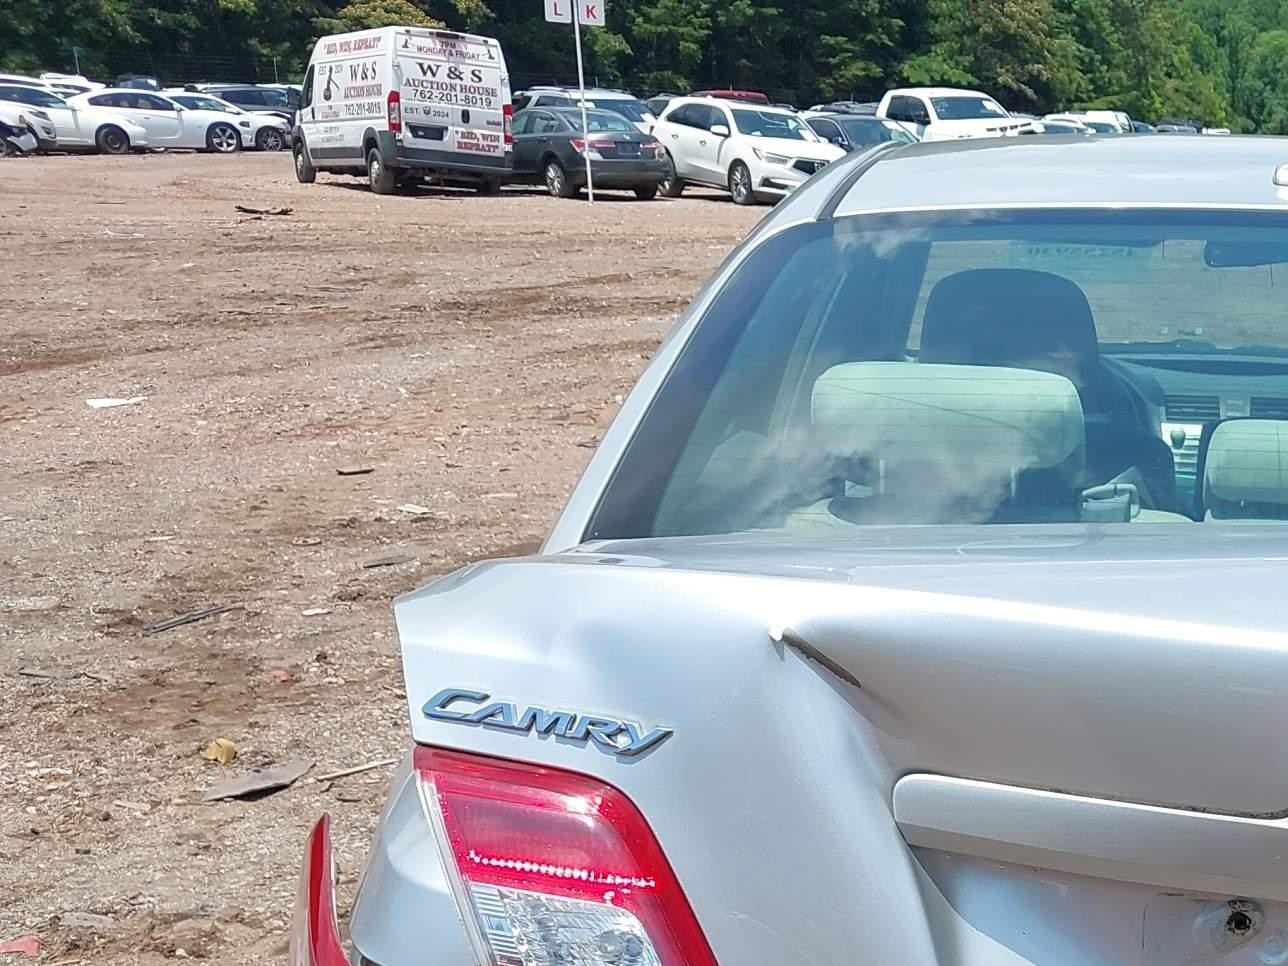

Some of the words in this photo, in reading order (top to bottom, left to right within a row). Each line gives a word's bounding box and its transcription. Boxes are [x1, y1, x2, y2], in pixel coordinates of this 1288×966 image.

[553, 2, 563, 16] L
[586, 4, 597, 19] K
[416, 45, 446, 56] MONDAY
[455, 50, 480, 61] FRIDAY
[349, 64, 360, 82] W
[361, 62, 369, 81] &
[371, 61, 377, 80] S
[416, 62, 442, 78] W
[447, 65, 464, 81] &
[470, 69, 482, 83] S
[344, 86, 365, 99] AUCTION
[366, 83, 382, 97] HOUSE
[403, 77, 457, 92] AUCTION
[460, 84, 498, 98] HOUSE
[412, 88, 492, 107] 762-201-8019
[345, 102, 381, 116] 762-201-8019
[480, 133, 501, 143] WIN
[422, 687, 674, 759] CAMRY
